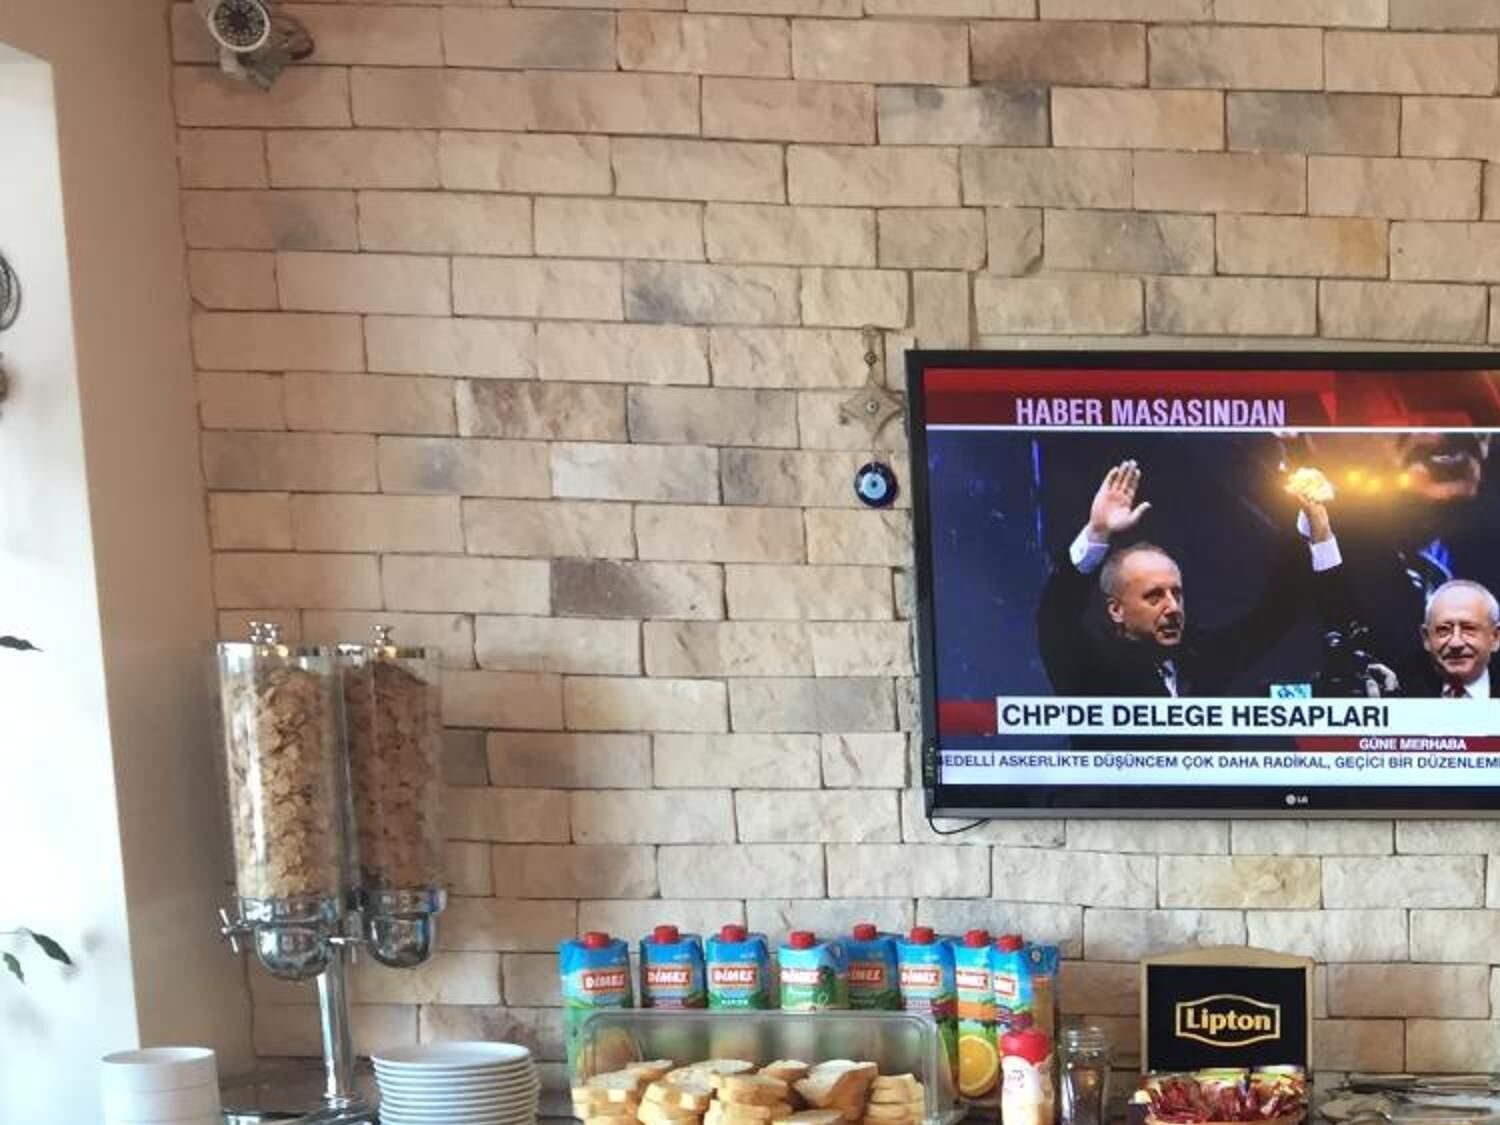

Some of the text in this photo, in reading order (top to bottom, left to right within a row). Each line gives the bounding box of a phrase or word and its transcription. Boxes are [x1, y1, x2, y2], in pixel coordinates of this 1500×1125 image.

[1015, 398, 1286, 426] HABER MASASINDAN
[1002, 704, 1390, 728] CHP'DE DELEGE HESAPLARI
[1400, 738, 1467, 750] MERHABA
[999, 752, 1089, 767] ASKERLİKTE
[1093, 751, 1178, 771] DÜŞÜNCEM
[1182, 755, 1214, 770] ÇOK
[1218, 755, 1260, 769] DAHA
[1186, 1007, 1271, 1035] Lipton
